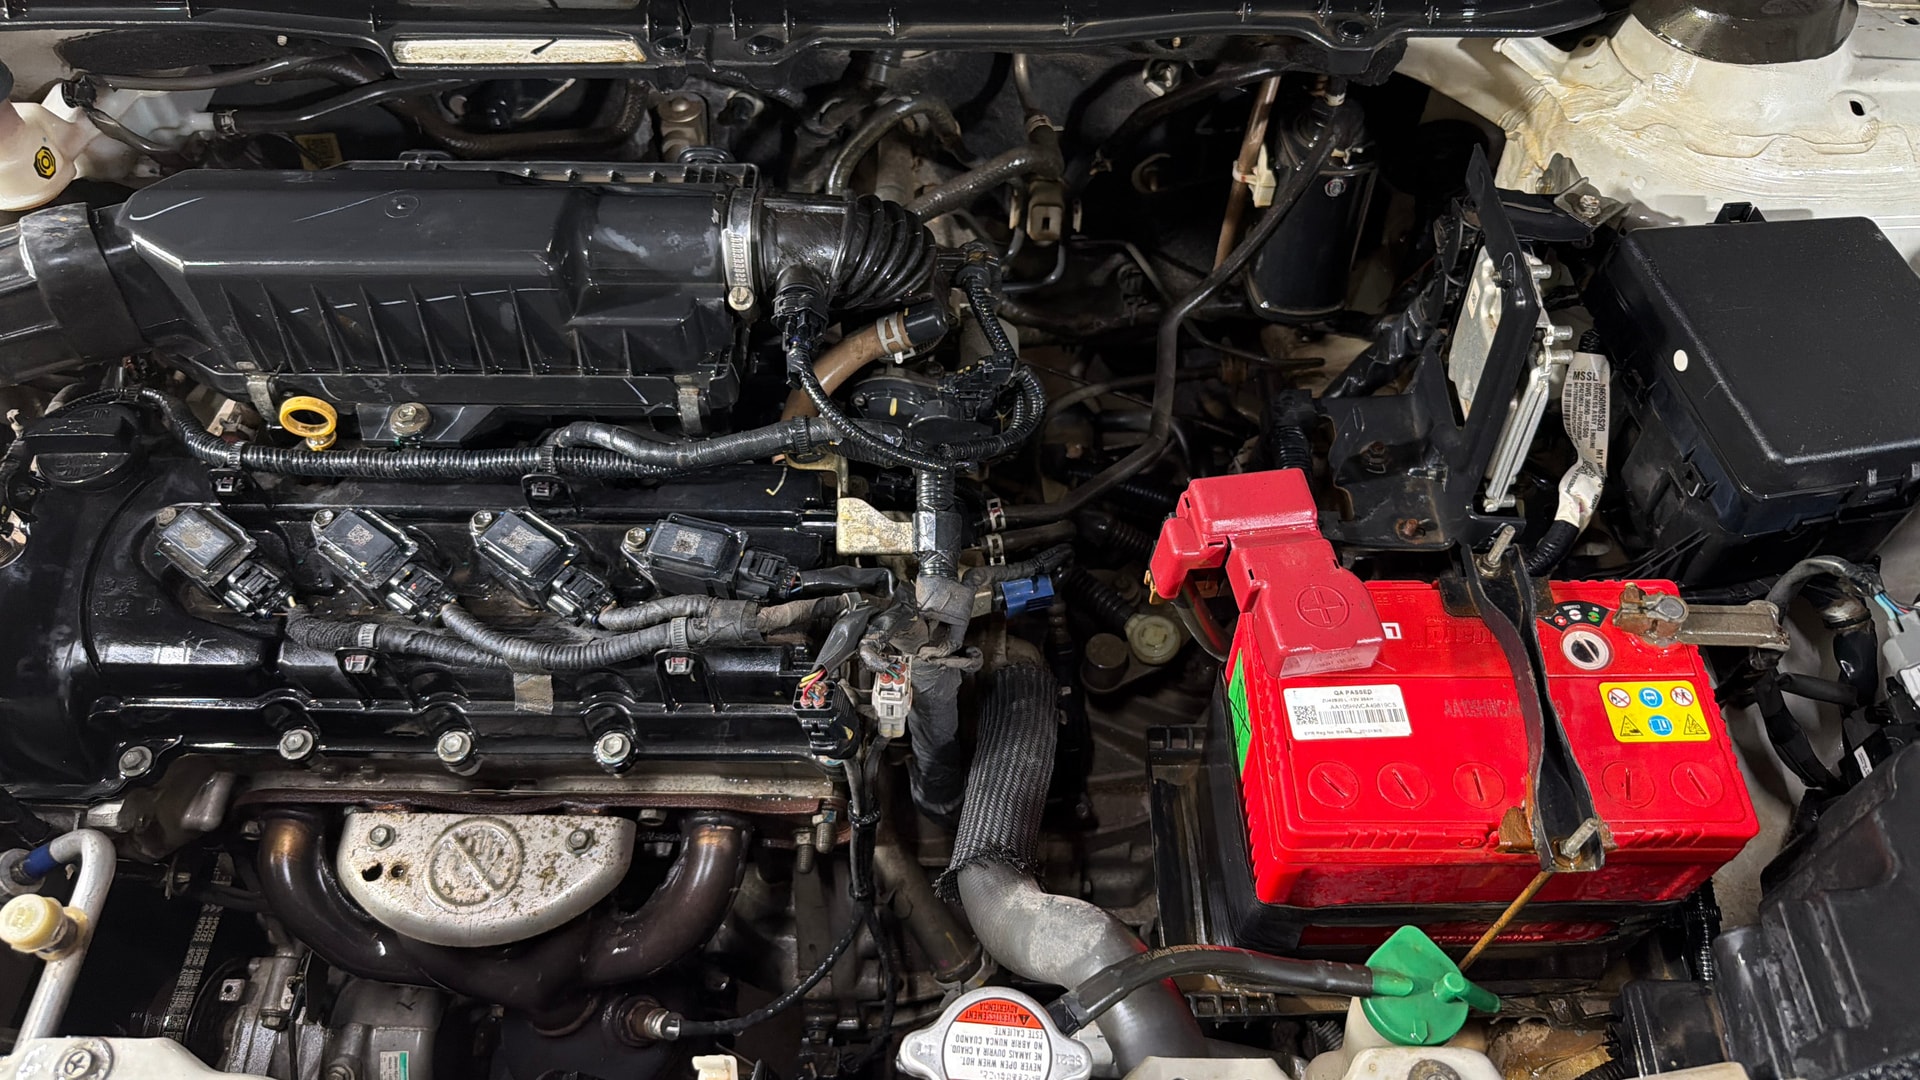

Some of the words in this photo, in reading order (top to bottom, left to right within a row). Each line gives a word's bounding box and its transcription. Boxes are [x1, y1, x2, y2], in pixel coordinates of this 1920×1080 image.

[1573, 371, 1598, 381] MSSL
[980, 1003, 1018, 1014] ADVERTENCIA
[965, 1010, 1018, 1022] AVERTISSEMENT
[956, 1034, 982, 1045] CUANDO
[1028, 1031, 1043, 1039] ESTE
[986, 1037, 1008, 1047] NUNCA
[1011, 1040, 1030, 1049] ABRIR
[1034, 1042, 1042, 1050] NO
[983, 1048, 1006, 1058] OUVRIR
[1009, 1050, 1031, 1060] JAMAIS
[1035, 1052, 1042, 1060] NE
[960, 1056, 974, 1066] HOT.
[978, 1058, 997, 1068] WHEN
[1000, 1061, 1017, 1070] OPEN
[1021, 1062, 1042, 1072] NEVER
